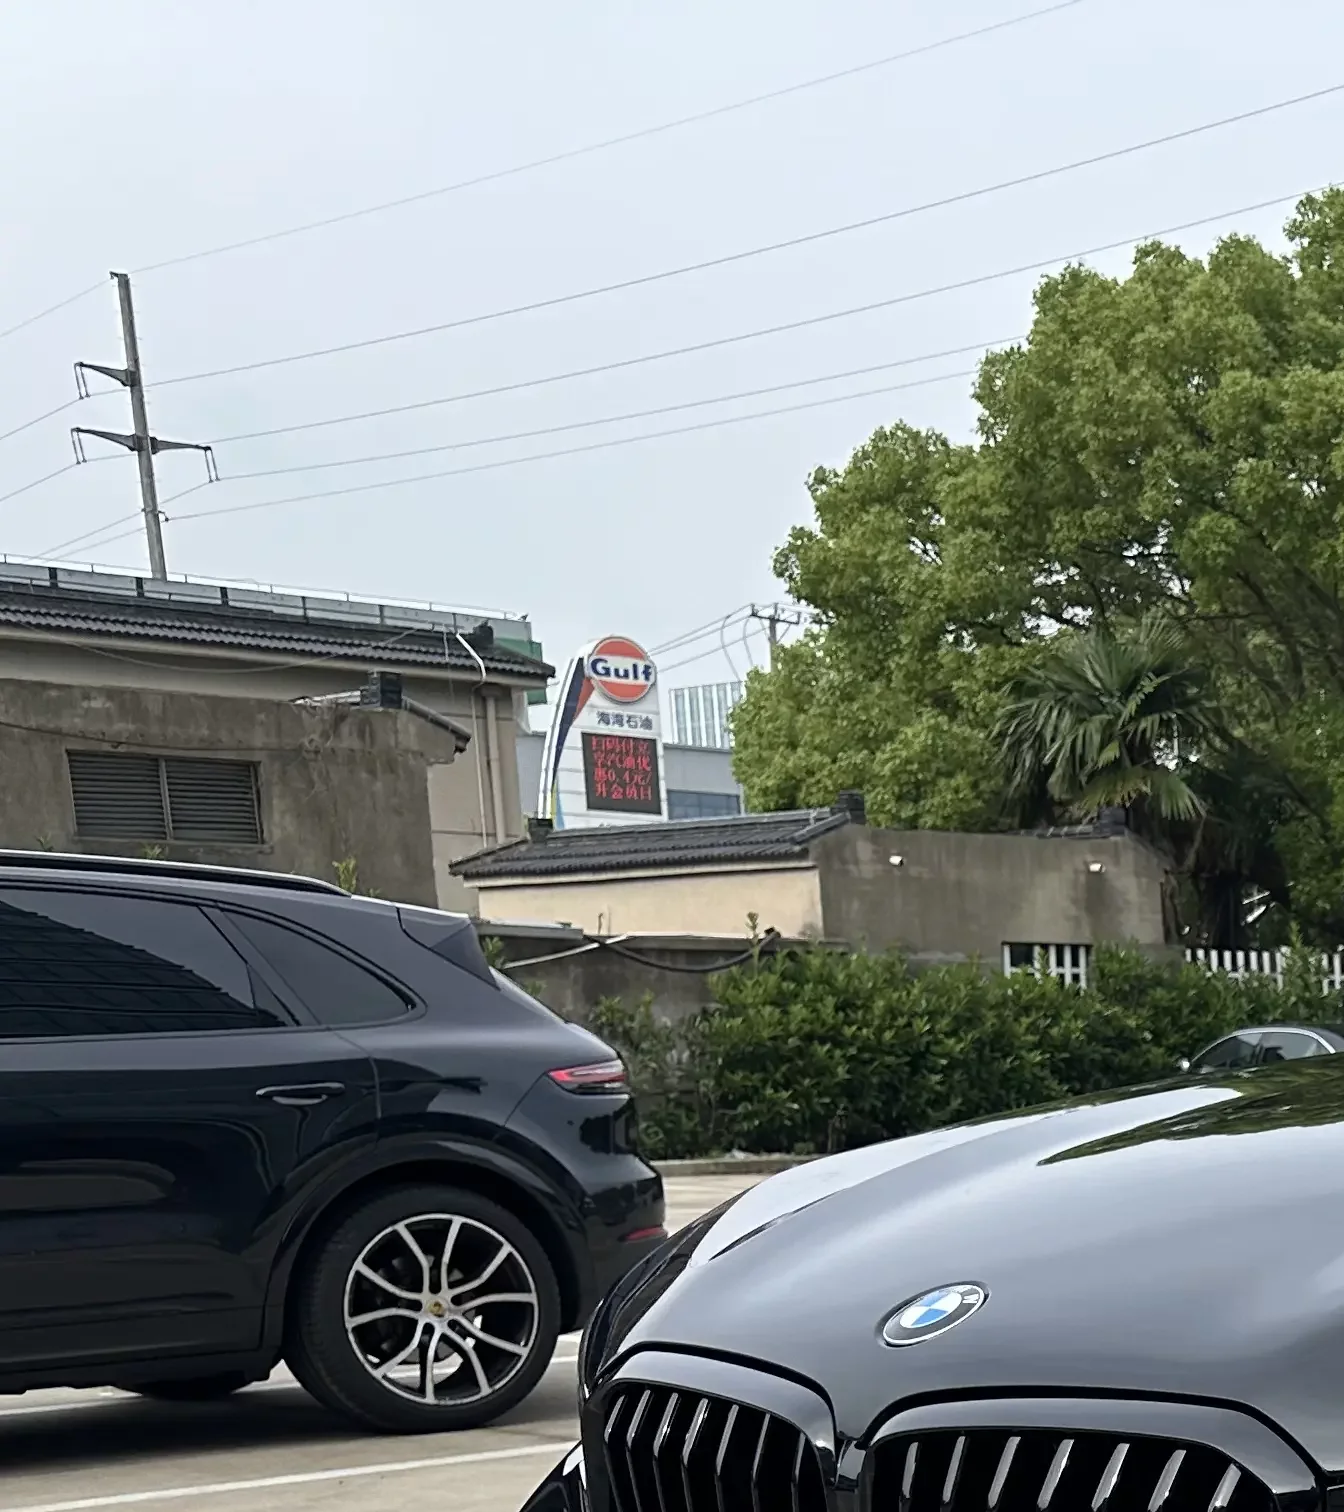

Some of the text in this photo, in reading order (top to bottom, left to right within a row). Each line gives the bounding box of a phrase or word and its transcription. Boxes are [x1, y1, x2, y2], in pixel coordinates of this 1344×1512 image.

[590, 658, 653, 681] Gulf
[597, 711, 653, 731] 海湾石油
